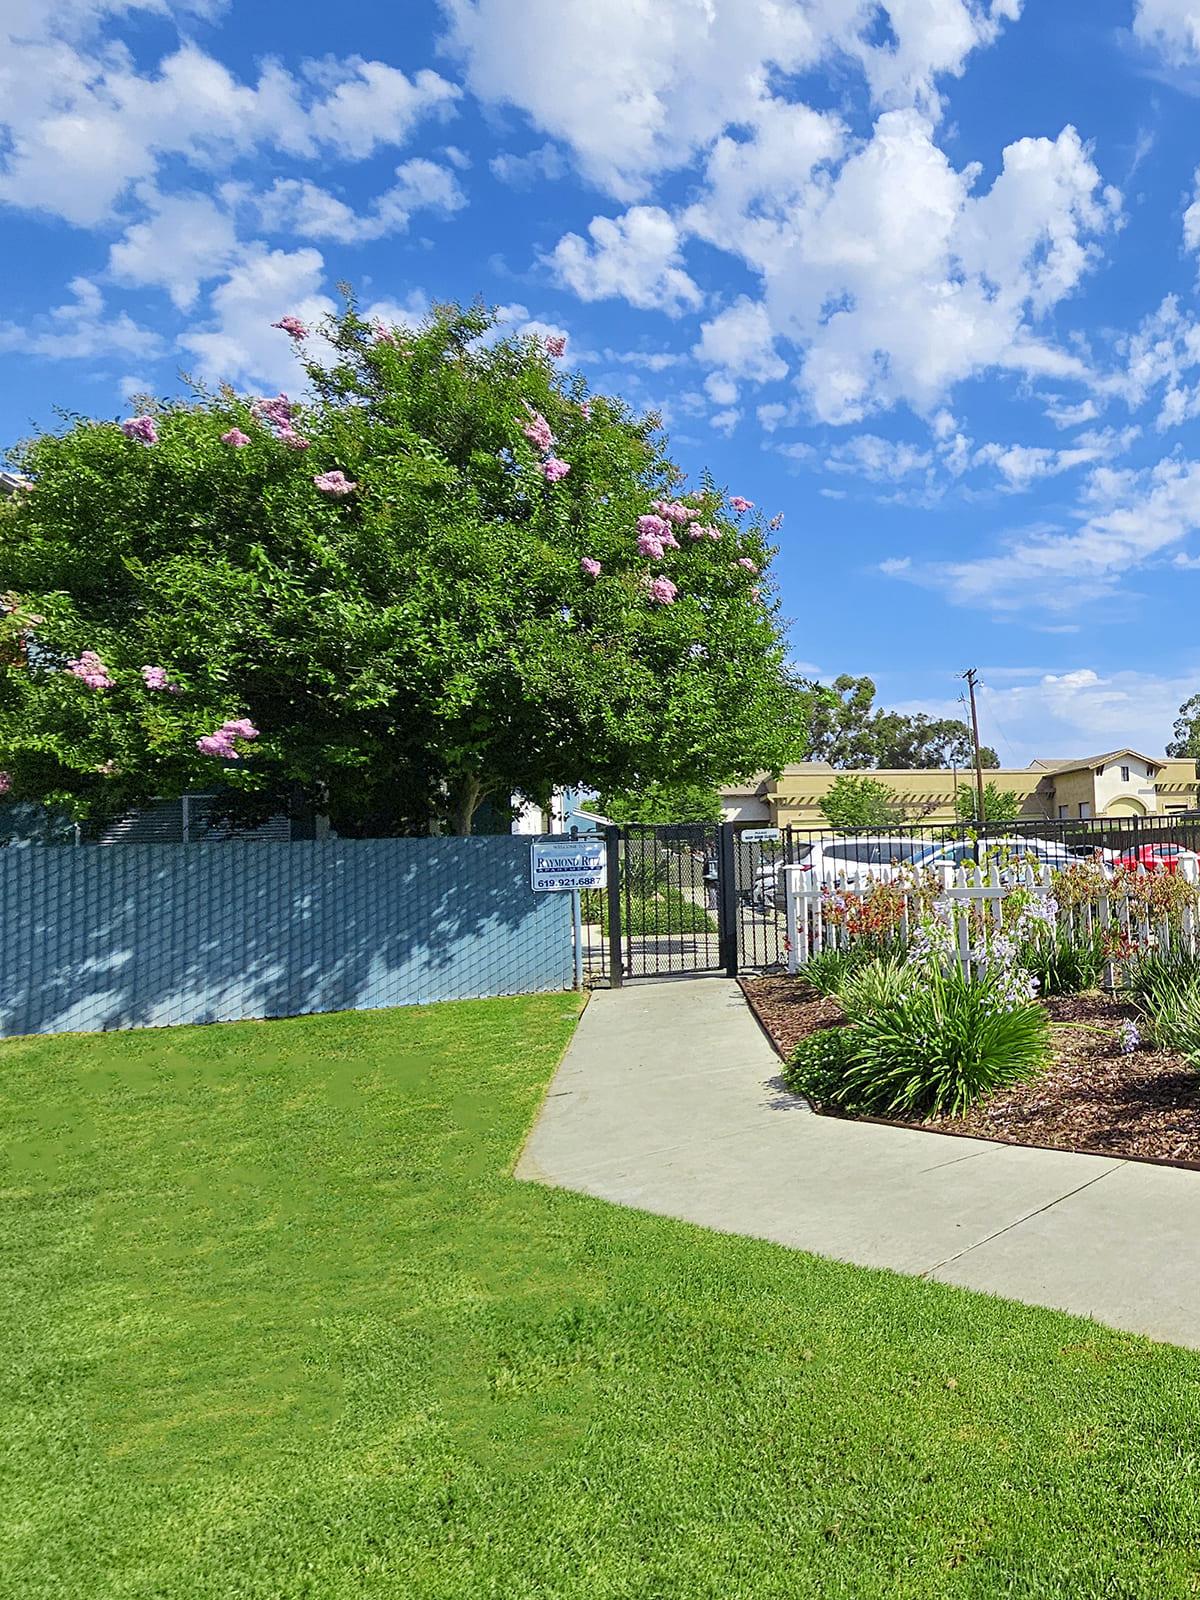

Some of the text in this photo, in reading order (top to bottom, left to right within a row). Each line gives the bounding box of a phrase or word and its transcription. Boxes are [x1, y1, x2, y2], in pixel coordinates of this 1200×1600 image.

[537, 855, 600, 867] RAYMOND RITZ
[538, 877, 600, 887] 619.921.6887
